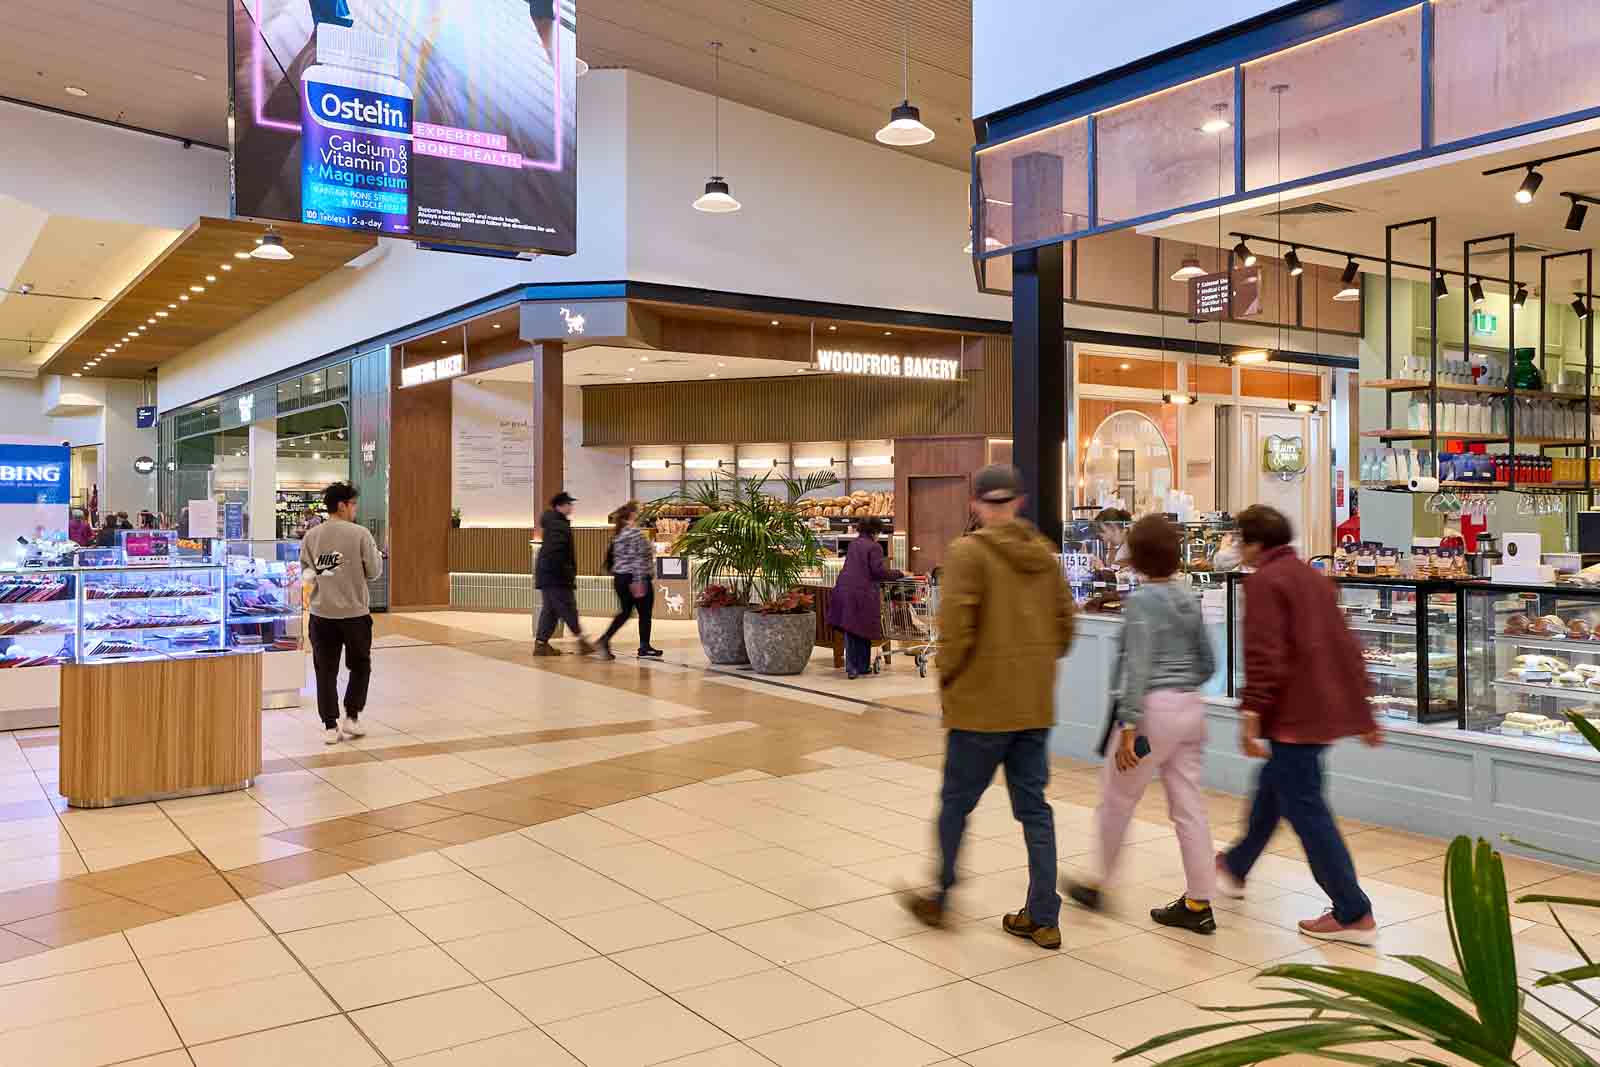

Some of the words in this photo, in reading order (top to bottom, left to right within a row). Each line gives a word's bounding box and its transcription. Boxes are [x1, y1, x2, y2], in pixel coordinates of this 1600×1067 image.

[321, 93, 405, 128] Ostelin
[416, 122, 481, 143] EXPERTS
[486, 134, 500, 146] IN
[329, 135, 395, 158] Calcium
[399, 145, 408, 160] &
[416, 142, 457, 157] BONE
[463, 148, 520, 168] HEALTH
[320, 148, 385, 172] Vitamin
[389, 158, 408, 175] D3
[320, 164, 408, 190] Magnesium
[351, 191, 373, 200] BONE
[351, 199, 384, 209] MUSCLE
[306, 209, 318, 219] 100
[320, 213, 346, 224] Tablets
[352, 217, 382, 229] 2-a-day
[817, 349, 900, 376] WOODFROG
[903, 356, 959, 380] BAKERY
[317, 553, 340, 566] NIKE
